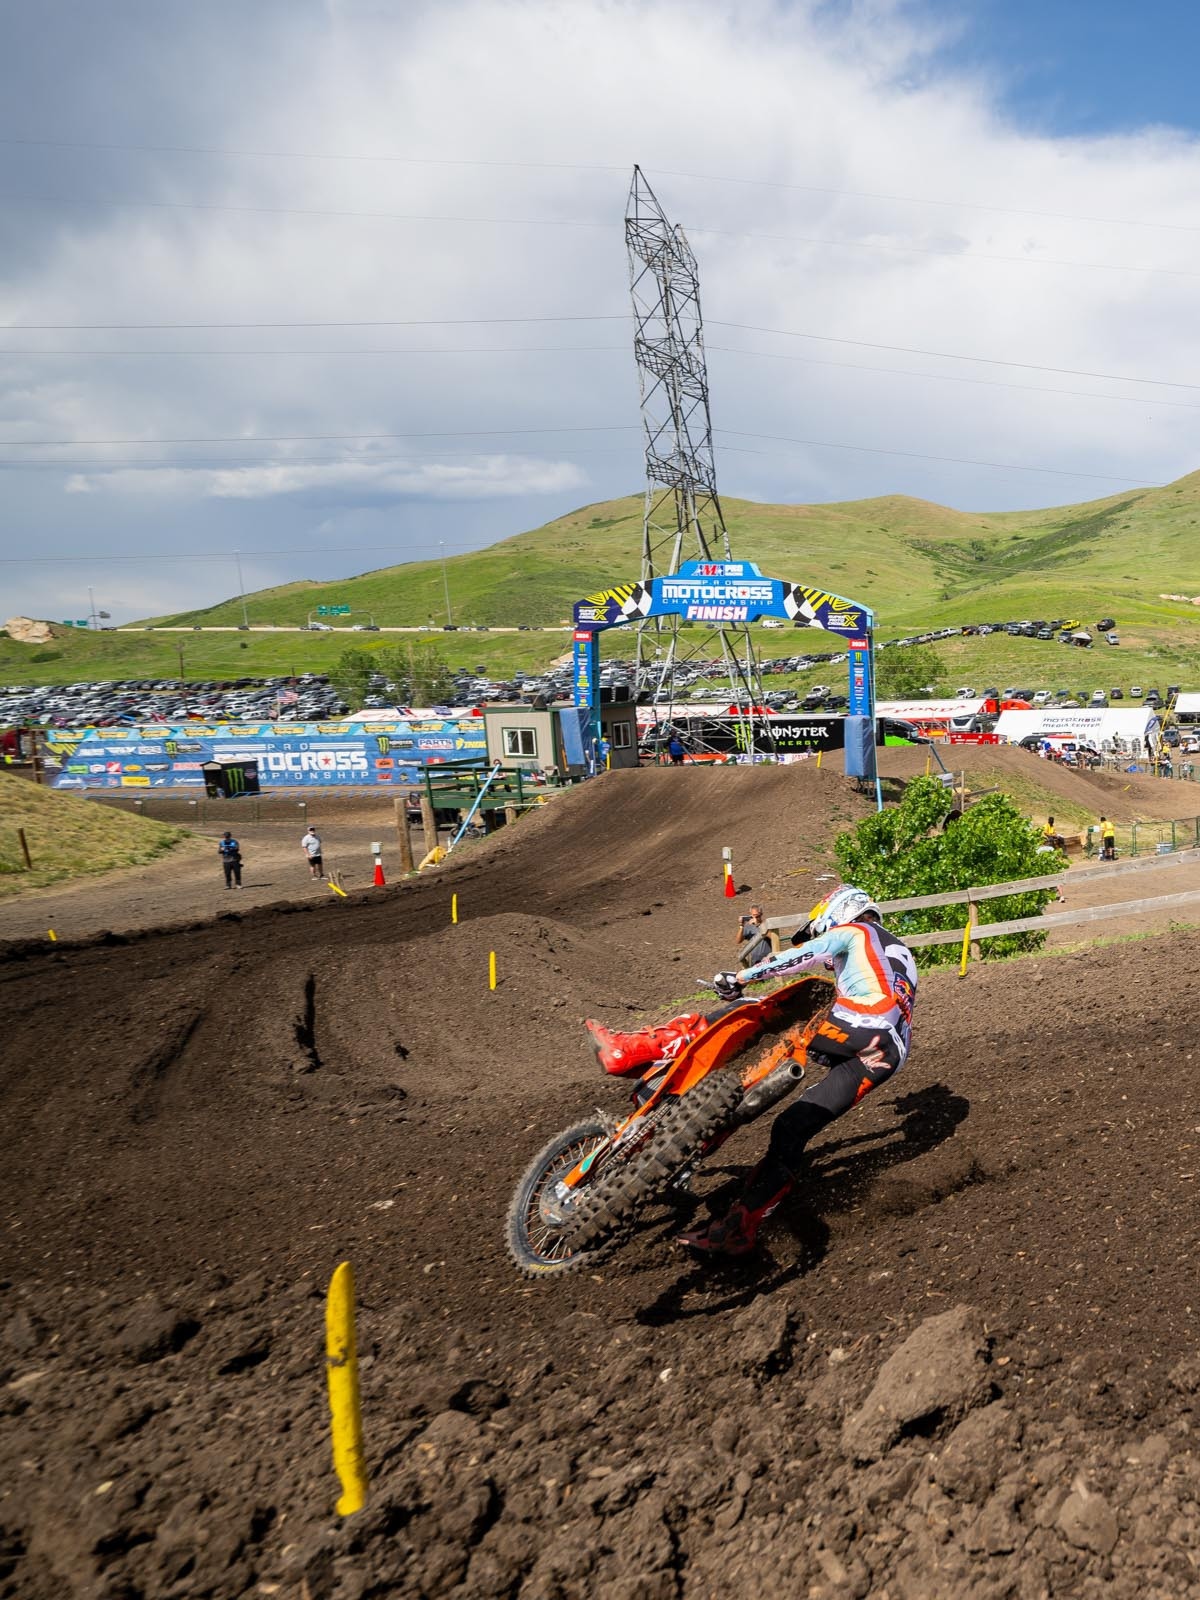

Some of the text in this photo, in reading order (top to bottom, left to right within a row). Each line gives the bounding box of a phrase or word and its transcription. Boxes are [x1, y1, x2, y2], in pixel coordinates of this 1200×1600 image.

[662, 585, 773, 600] MOTOCROSS
[686, 606, 748, 620] FINISH
[760, 726, 829, 740] MONSTER
[267, 743, 309, 751] PRO
[213, 751, 369, 771] TOCROSS
[257, 771, 369, 779] MPIONSHIP
